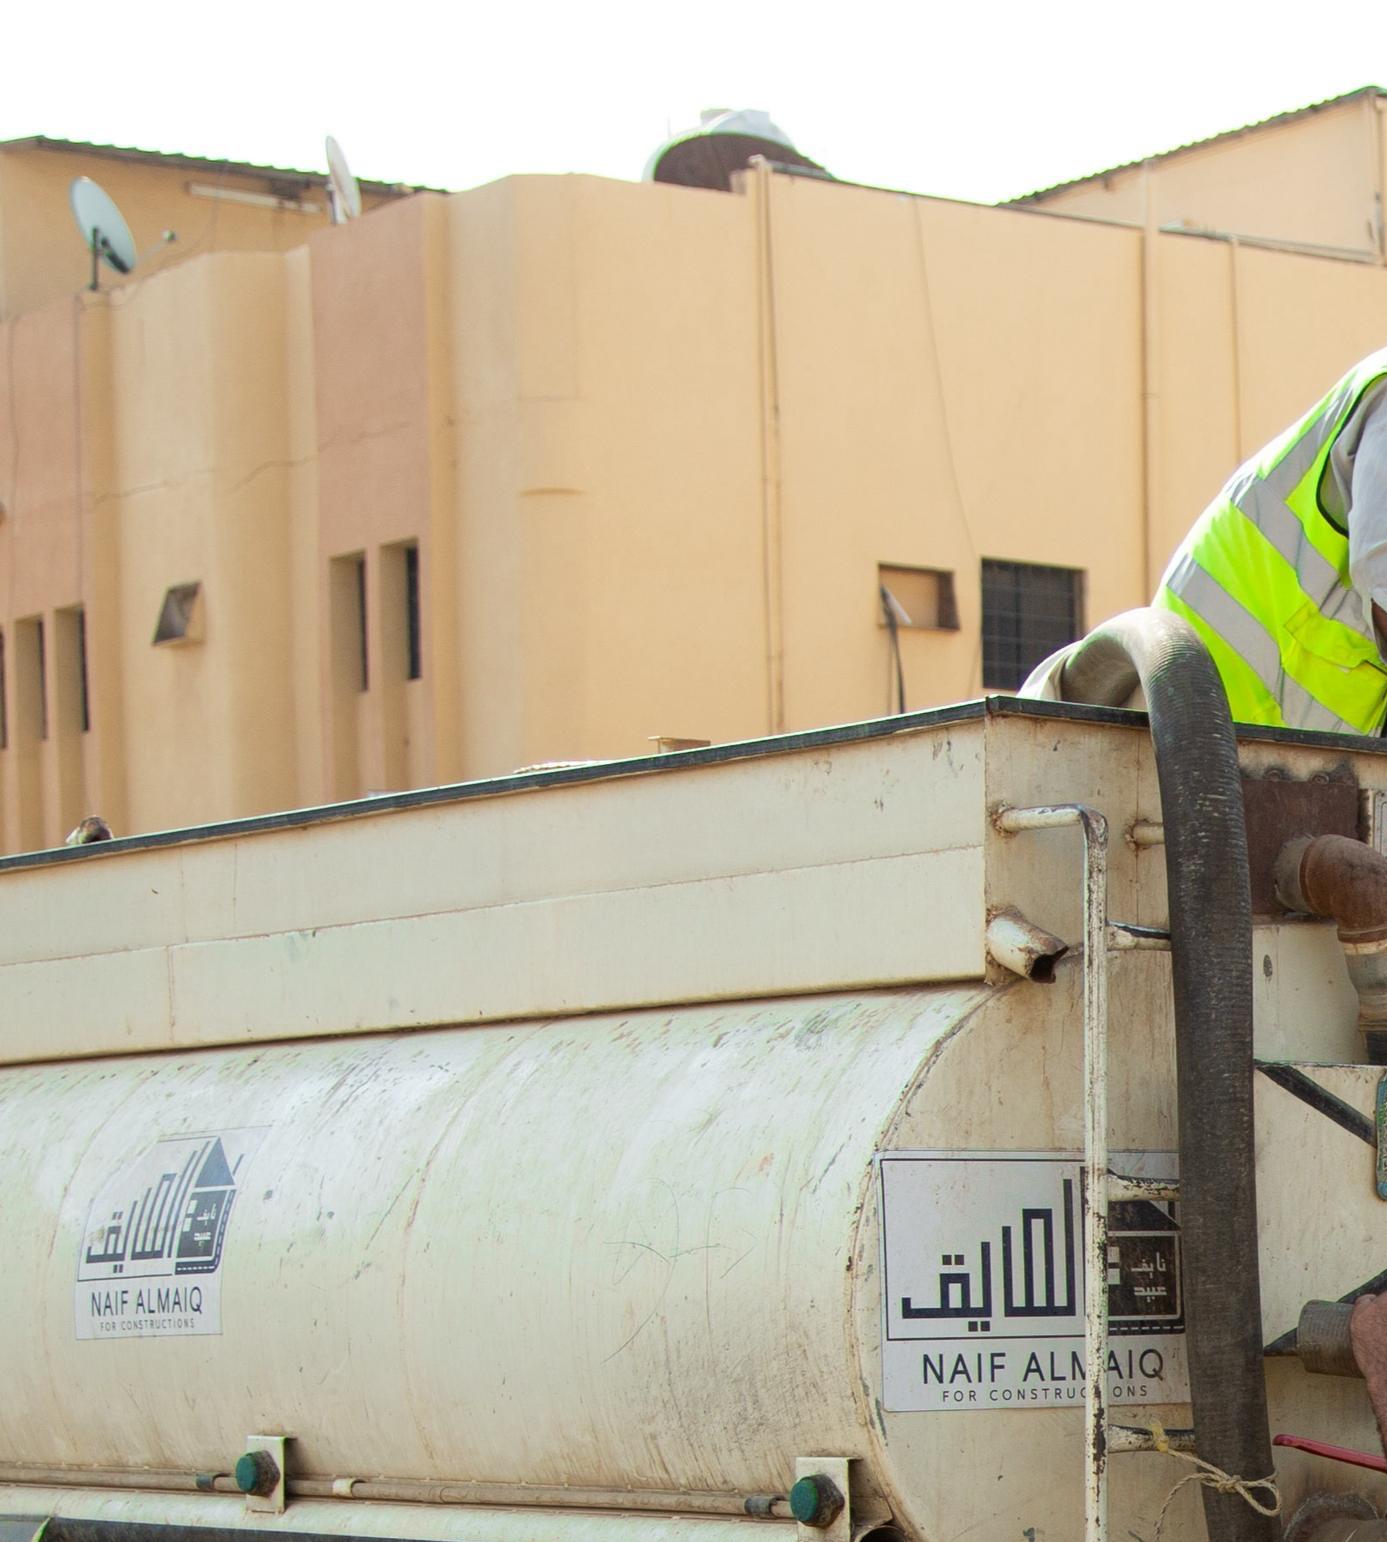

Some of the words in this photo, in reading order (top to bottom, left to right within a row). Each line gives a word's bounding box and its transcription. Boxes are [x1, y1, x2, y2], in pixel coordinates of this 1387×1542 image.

[1130, 1252, 1167, 1279] نايف
[91, 1290, 129, 1317] NAIF
[135, 1286, 203, 1315] ALMAIQ
[1133, 1286, 1168, 1302] عبيد
[100, 1321, 117, 1332] FOR
[120, 1317, 195, 1331] CONSTRUCTIONS
[922, 1352, 1006, 1384] NAIF
[942, 1390, 978, 1402] FOR
[989, 1385, 1148, 1401] CONSTRUCONS
